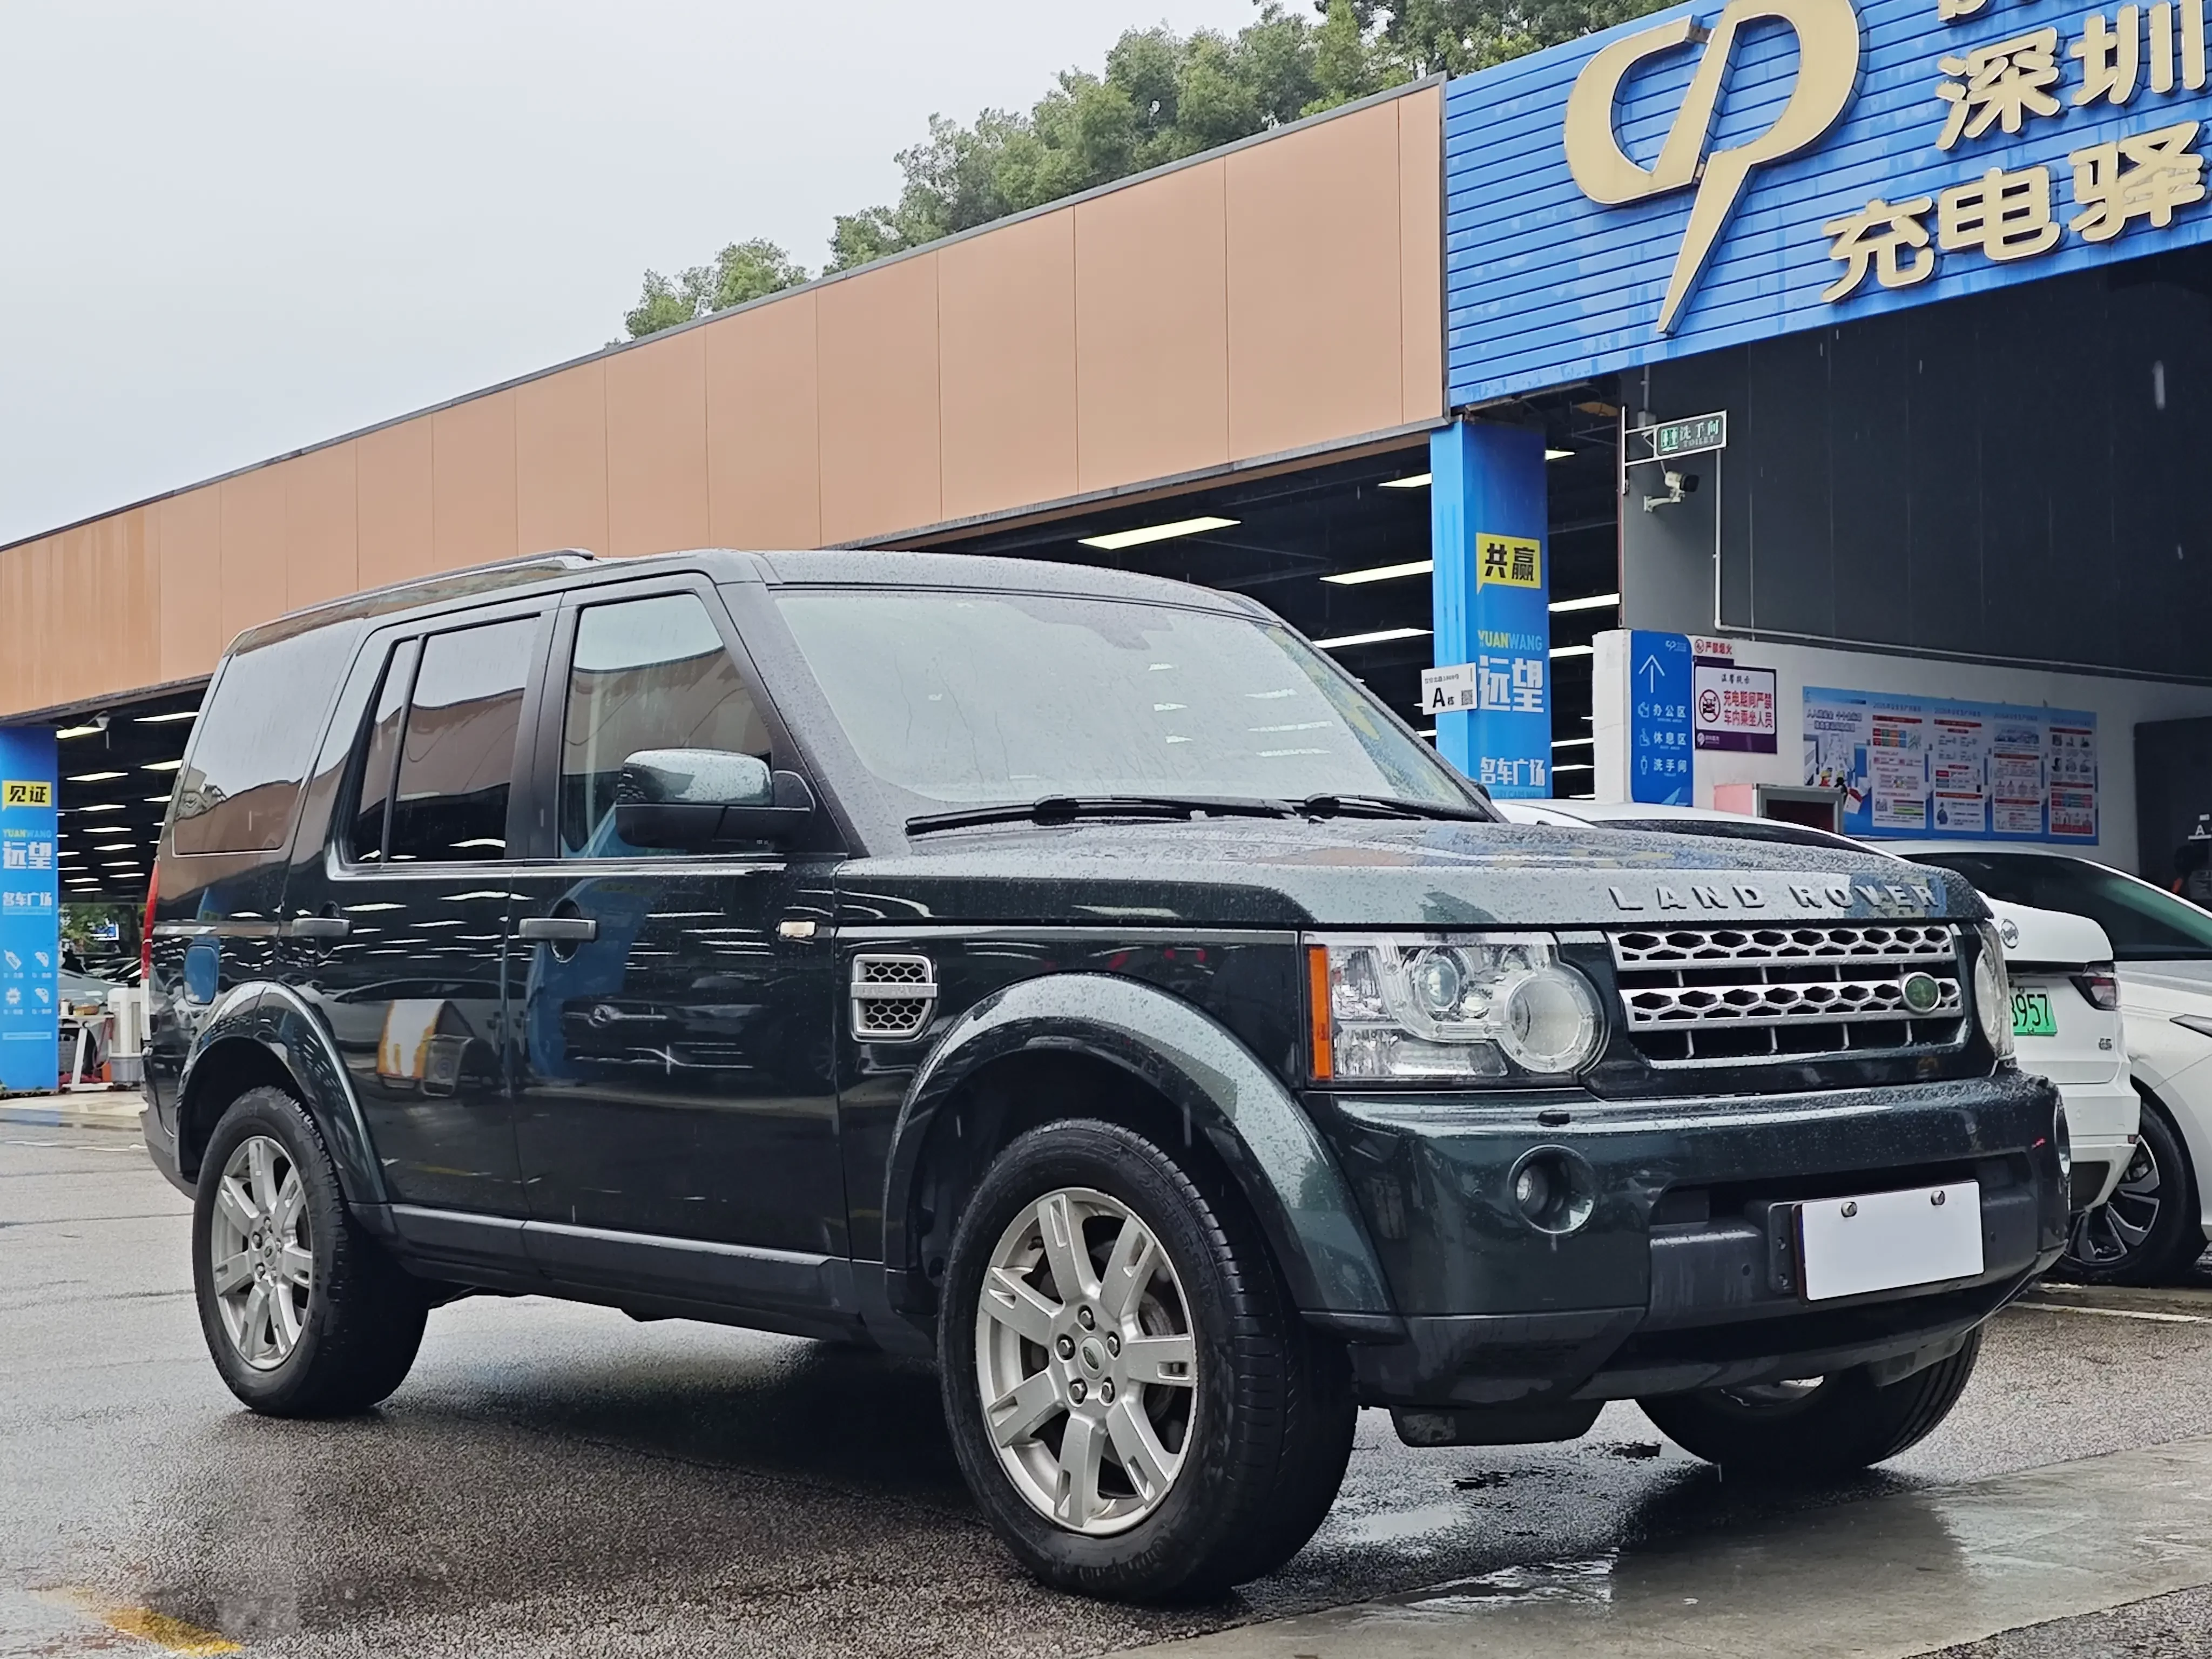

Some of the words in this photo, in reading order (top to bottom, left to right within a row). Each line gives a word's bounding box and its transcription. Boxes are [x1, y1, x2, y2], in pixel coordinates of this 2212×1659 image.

[1936, 0, 2205, 151] 深圳
[1821, 120, 2206, 302] 充电驿
[1485, 543, 1535, 582] 共赢
[1477, 629, 1543, 651] YUANWANG
[1478, 655, 1544, 713] 远望
[1723, 689, 1772, 710] 充电期间严禁
[1653, 703, 1686, 718] 办公区
[1724, 709, 1773, 728] 车内乘坐人员
[1654, 731, 1687, 746] 休息区
[1481, 757, 1546, 786] 名车广场
[1653, 758, 1687, 773] 洗手间
[9, 785, 48, 802] 见证
[3, 828, 52, 838] YUANWANG
[2, 841, 52, 869] 远望
[2, 892, 52, 907] 名车广场
[1608, 884, 1766, 910] LAND
[1789, 884, 1939, 908] ROVER
